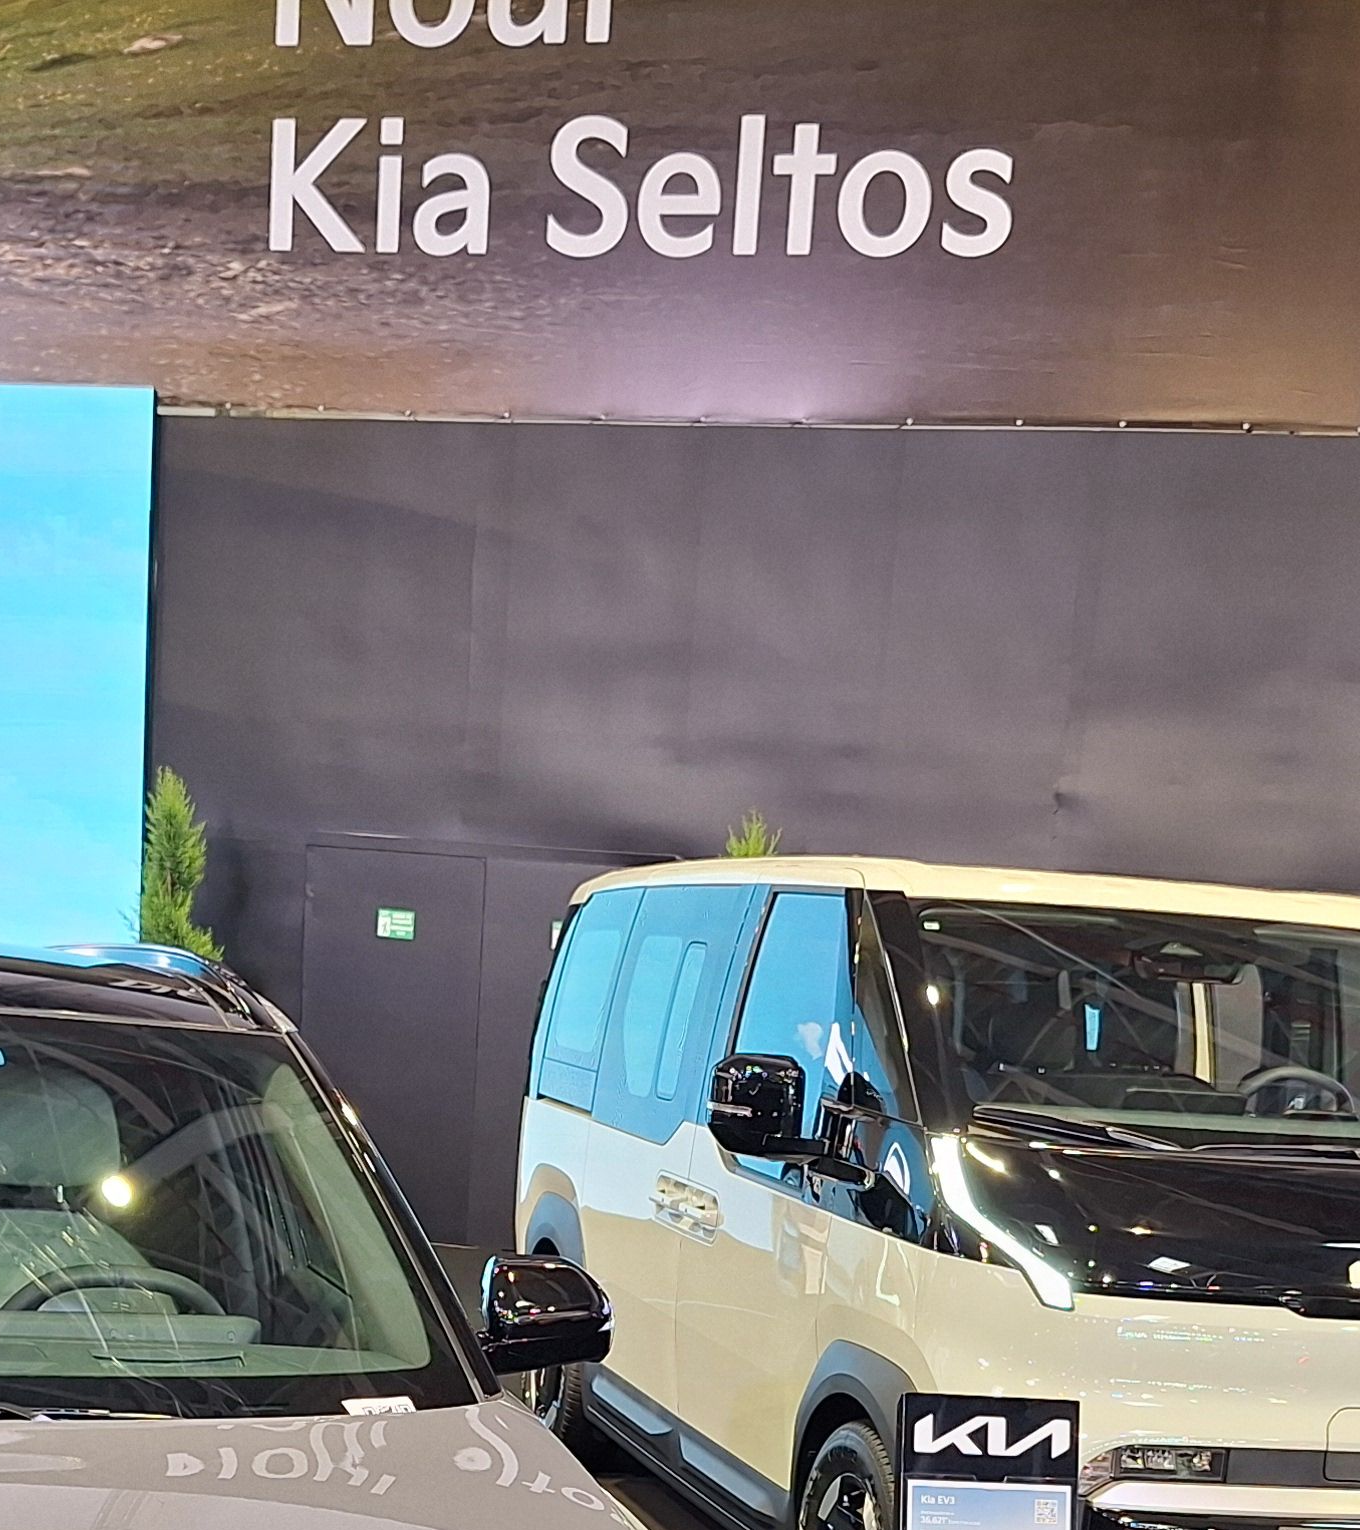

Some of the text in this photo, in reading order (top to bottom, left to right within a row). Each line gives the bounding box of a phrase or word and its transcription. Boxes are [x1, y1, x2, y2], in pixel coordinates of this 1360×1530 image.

[268, 114, 1014, 258] Kia Seltos
[913, 1413, 1071, 1459] KIA
